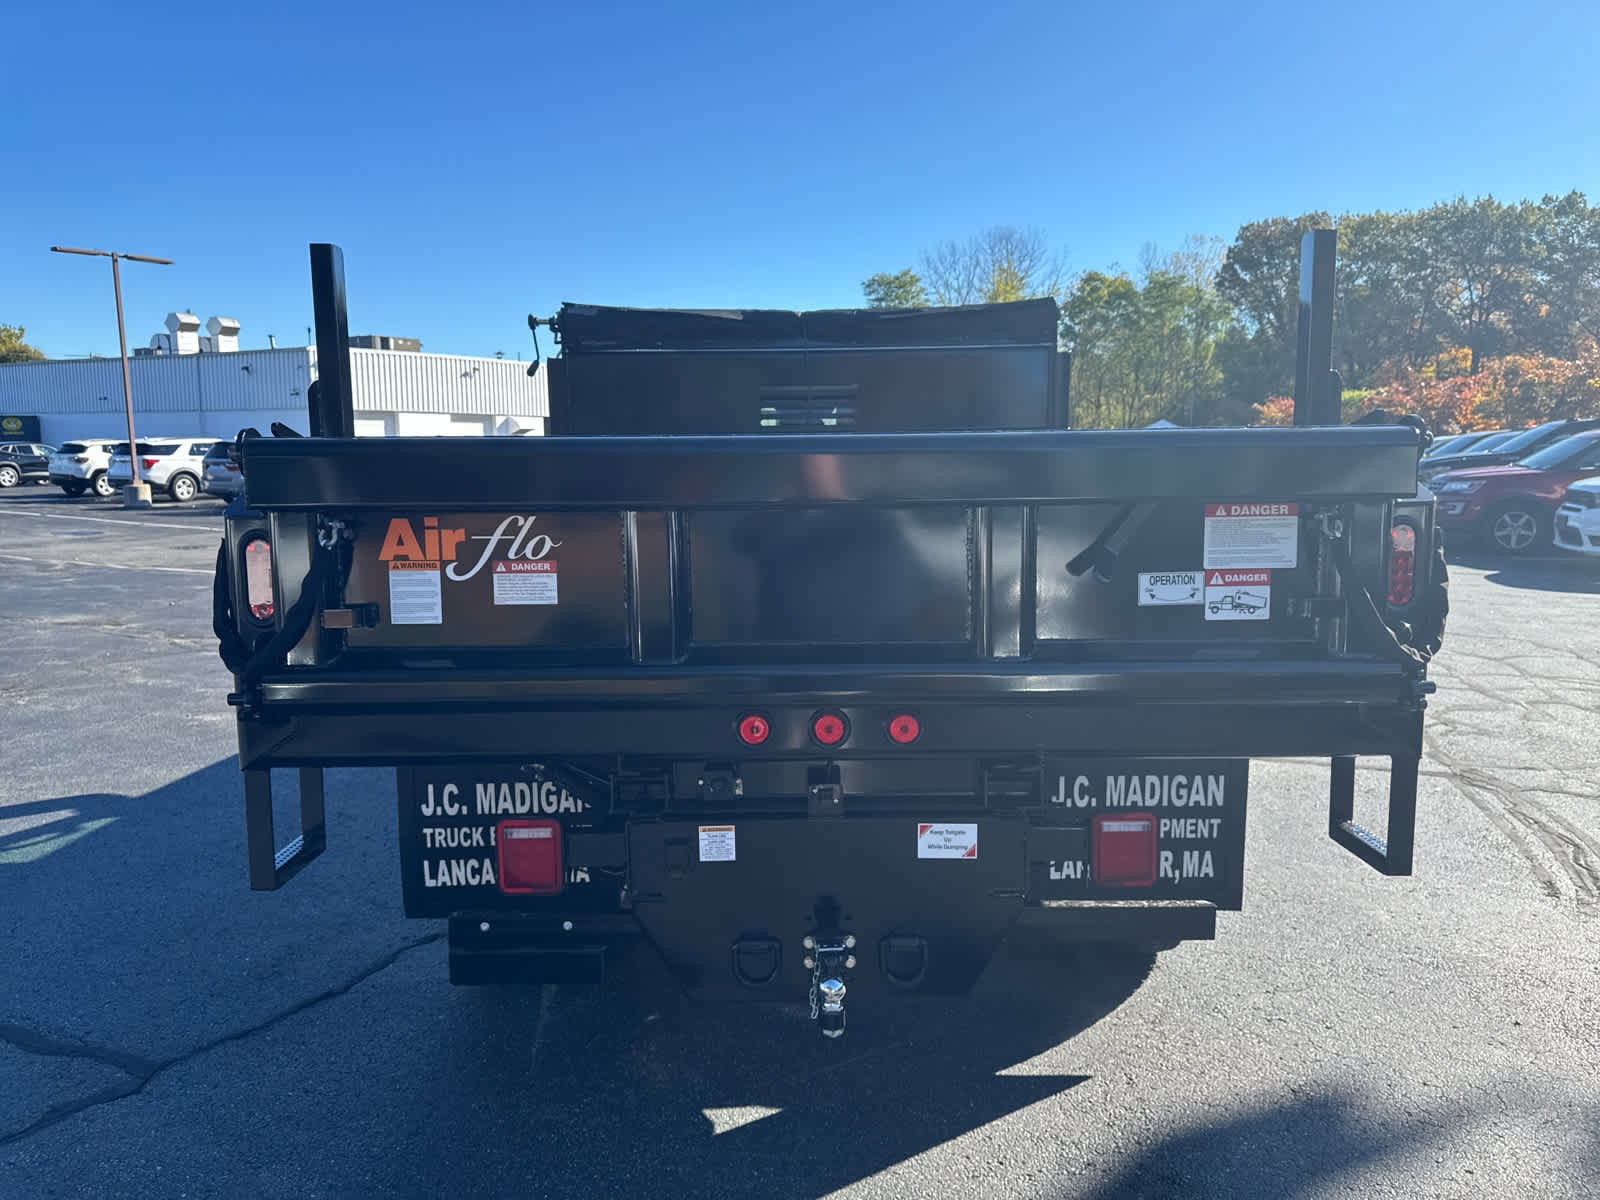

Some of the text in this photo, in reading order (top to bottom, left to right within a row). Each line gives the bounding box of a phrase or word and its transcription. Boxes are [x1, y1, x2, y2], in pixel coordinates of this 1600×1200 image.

[1231, 504, 1289, 516] DANGER
[378, 515, 562, 582] Air flo
[400, 562, 438, 570] WARNING
[511, 562, 551, 571] DANGER
[1149, 574, 1196, 586] OPERATION
[1224, 573, 1268, 583] DANGER
[1051, 774, 1225, 808] J.C. MADIGAN
[421, 783, 468, 816] J.C.
[1159, 818, 1222, 839] PMENT
[422, 826, 485, 848] TRUCK
